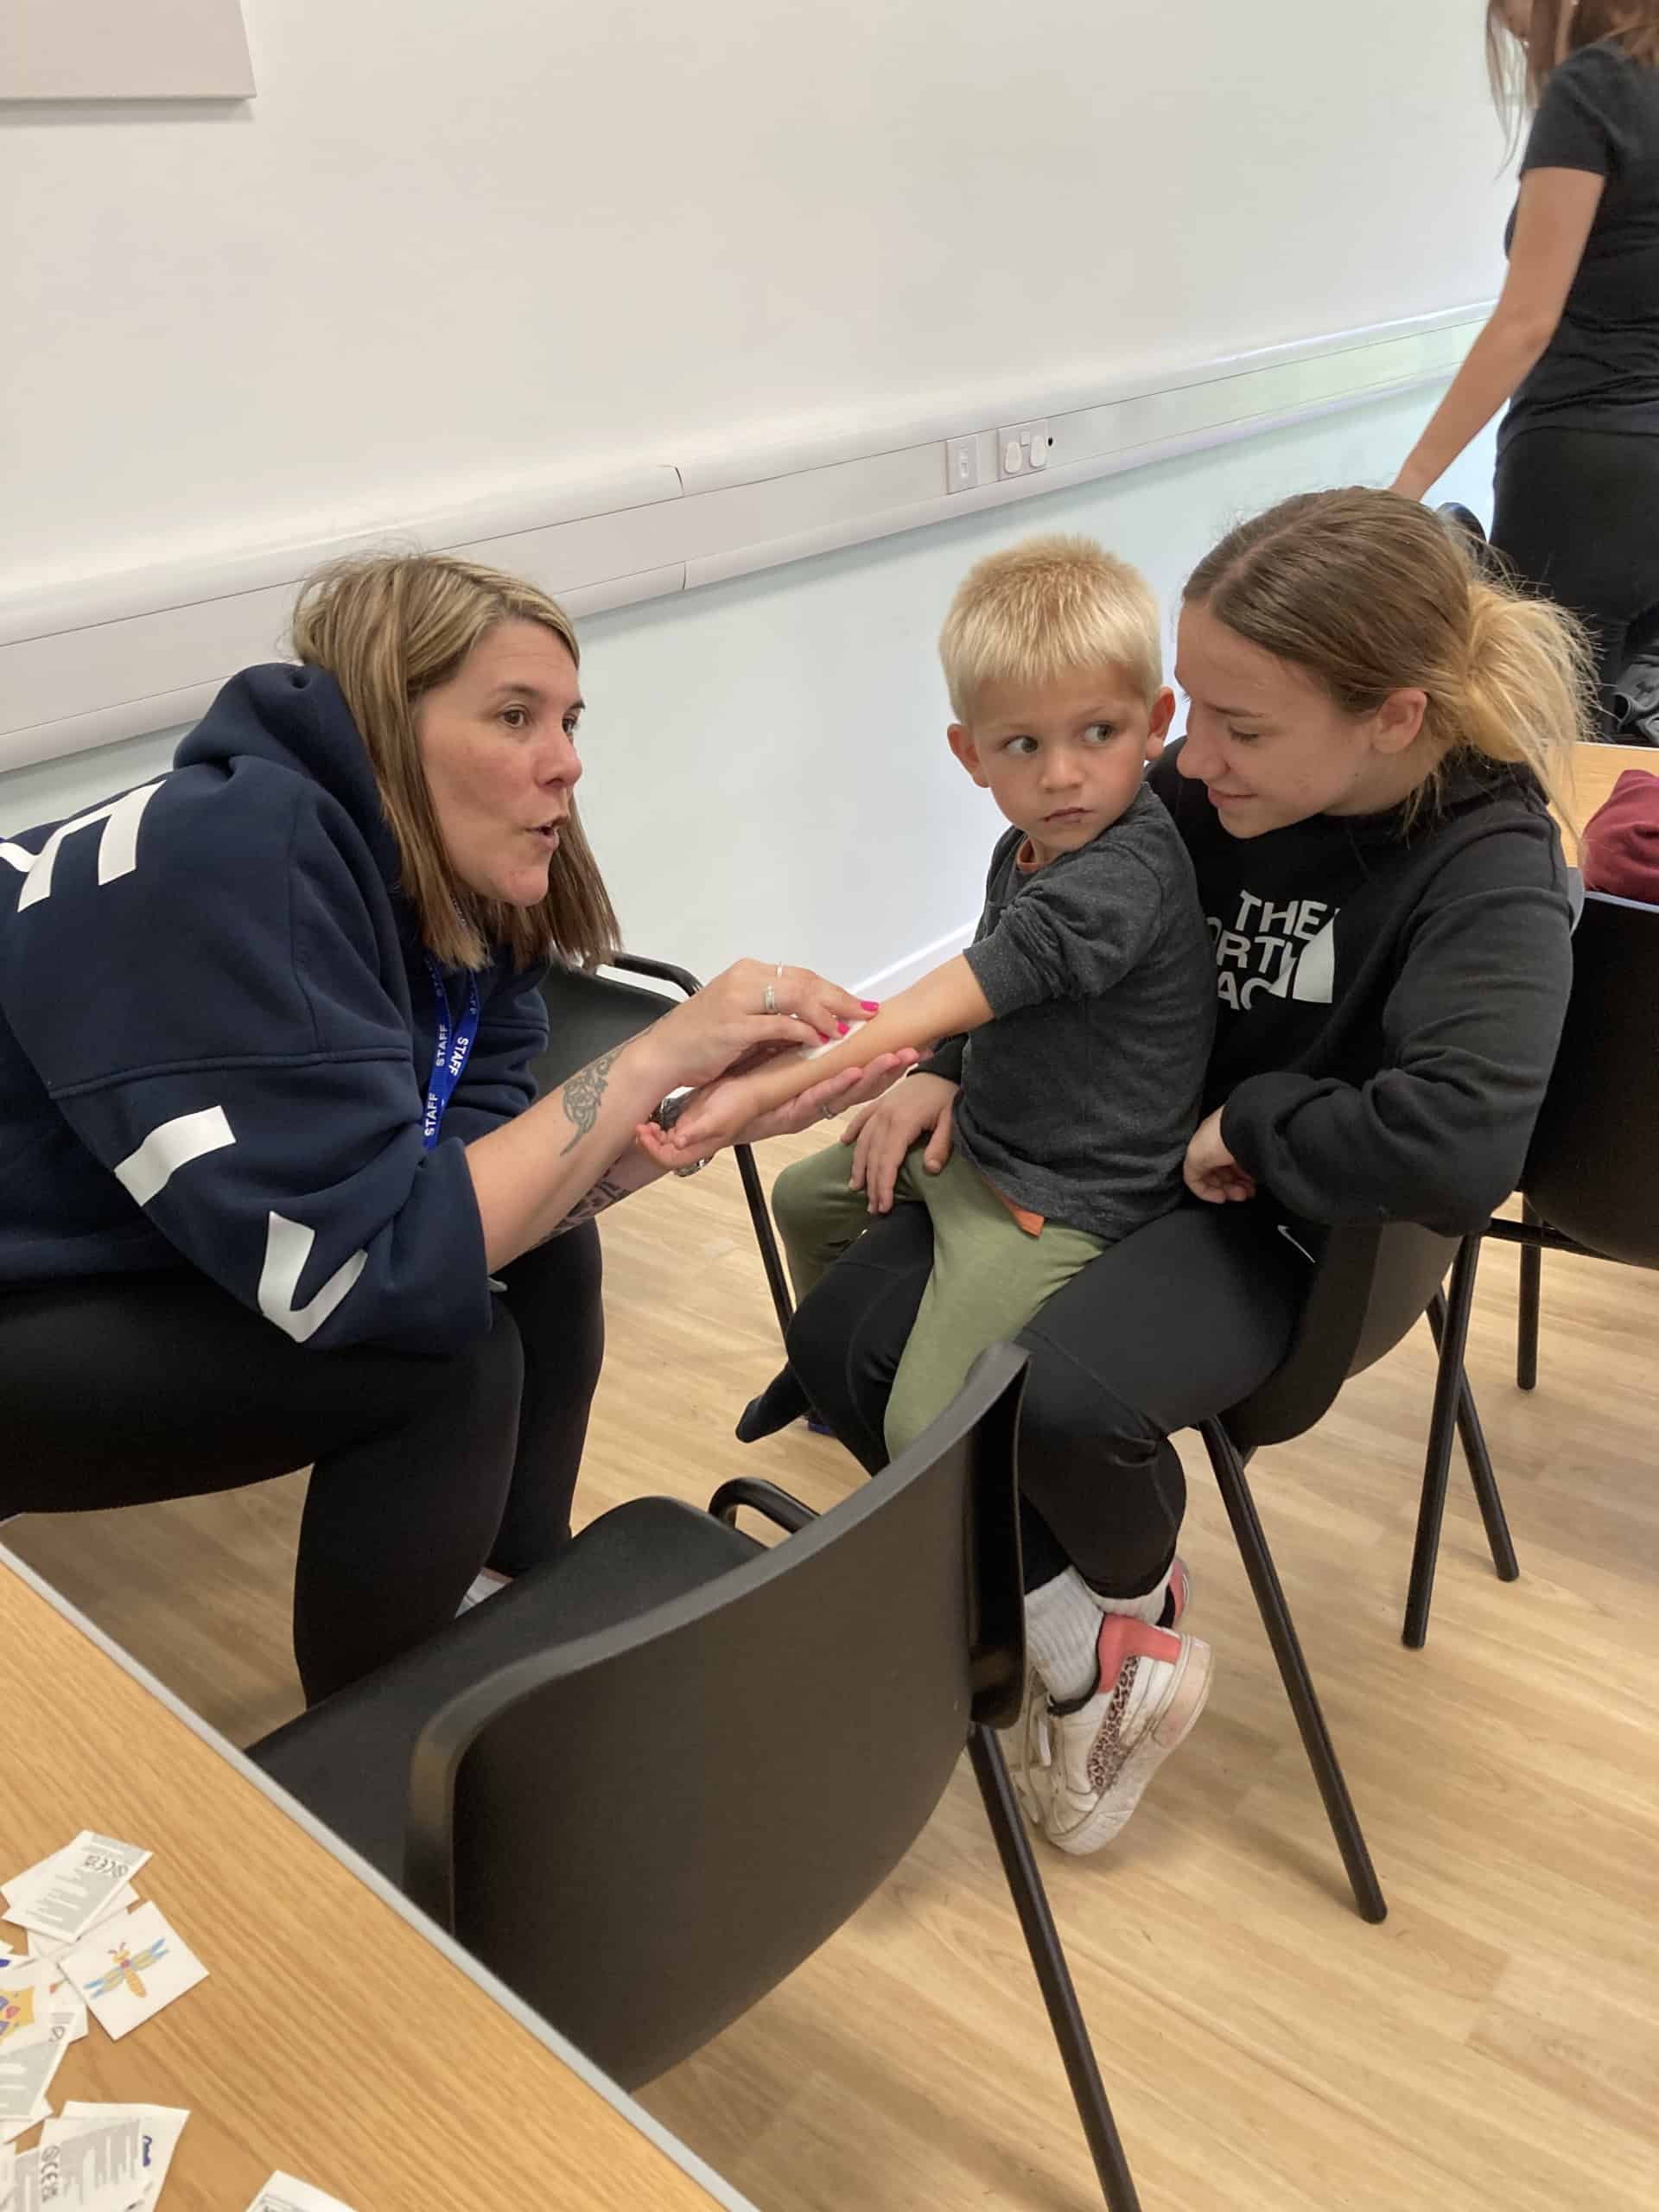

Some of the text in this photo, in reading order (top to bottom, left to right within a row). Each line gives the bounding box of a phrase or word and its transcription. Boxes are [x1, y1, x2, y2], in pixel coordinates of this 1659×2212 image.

[1235, 889, 1328, 940] THE
[435, 1023, 449, 1067] STAFF
[448, 1036, 469, 1077] STAFF
[424, 1092, 439, 1137] STAFF
